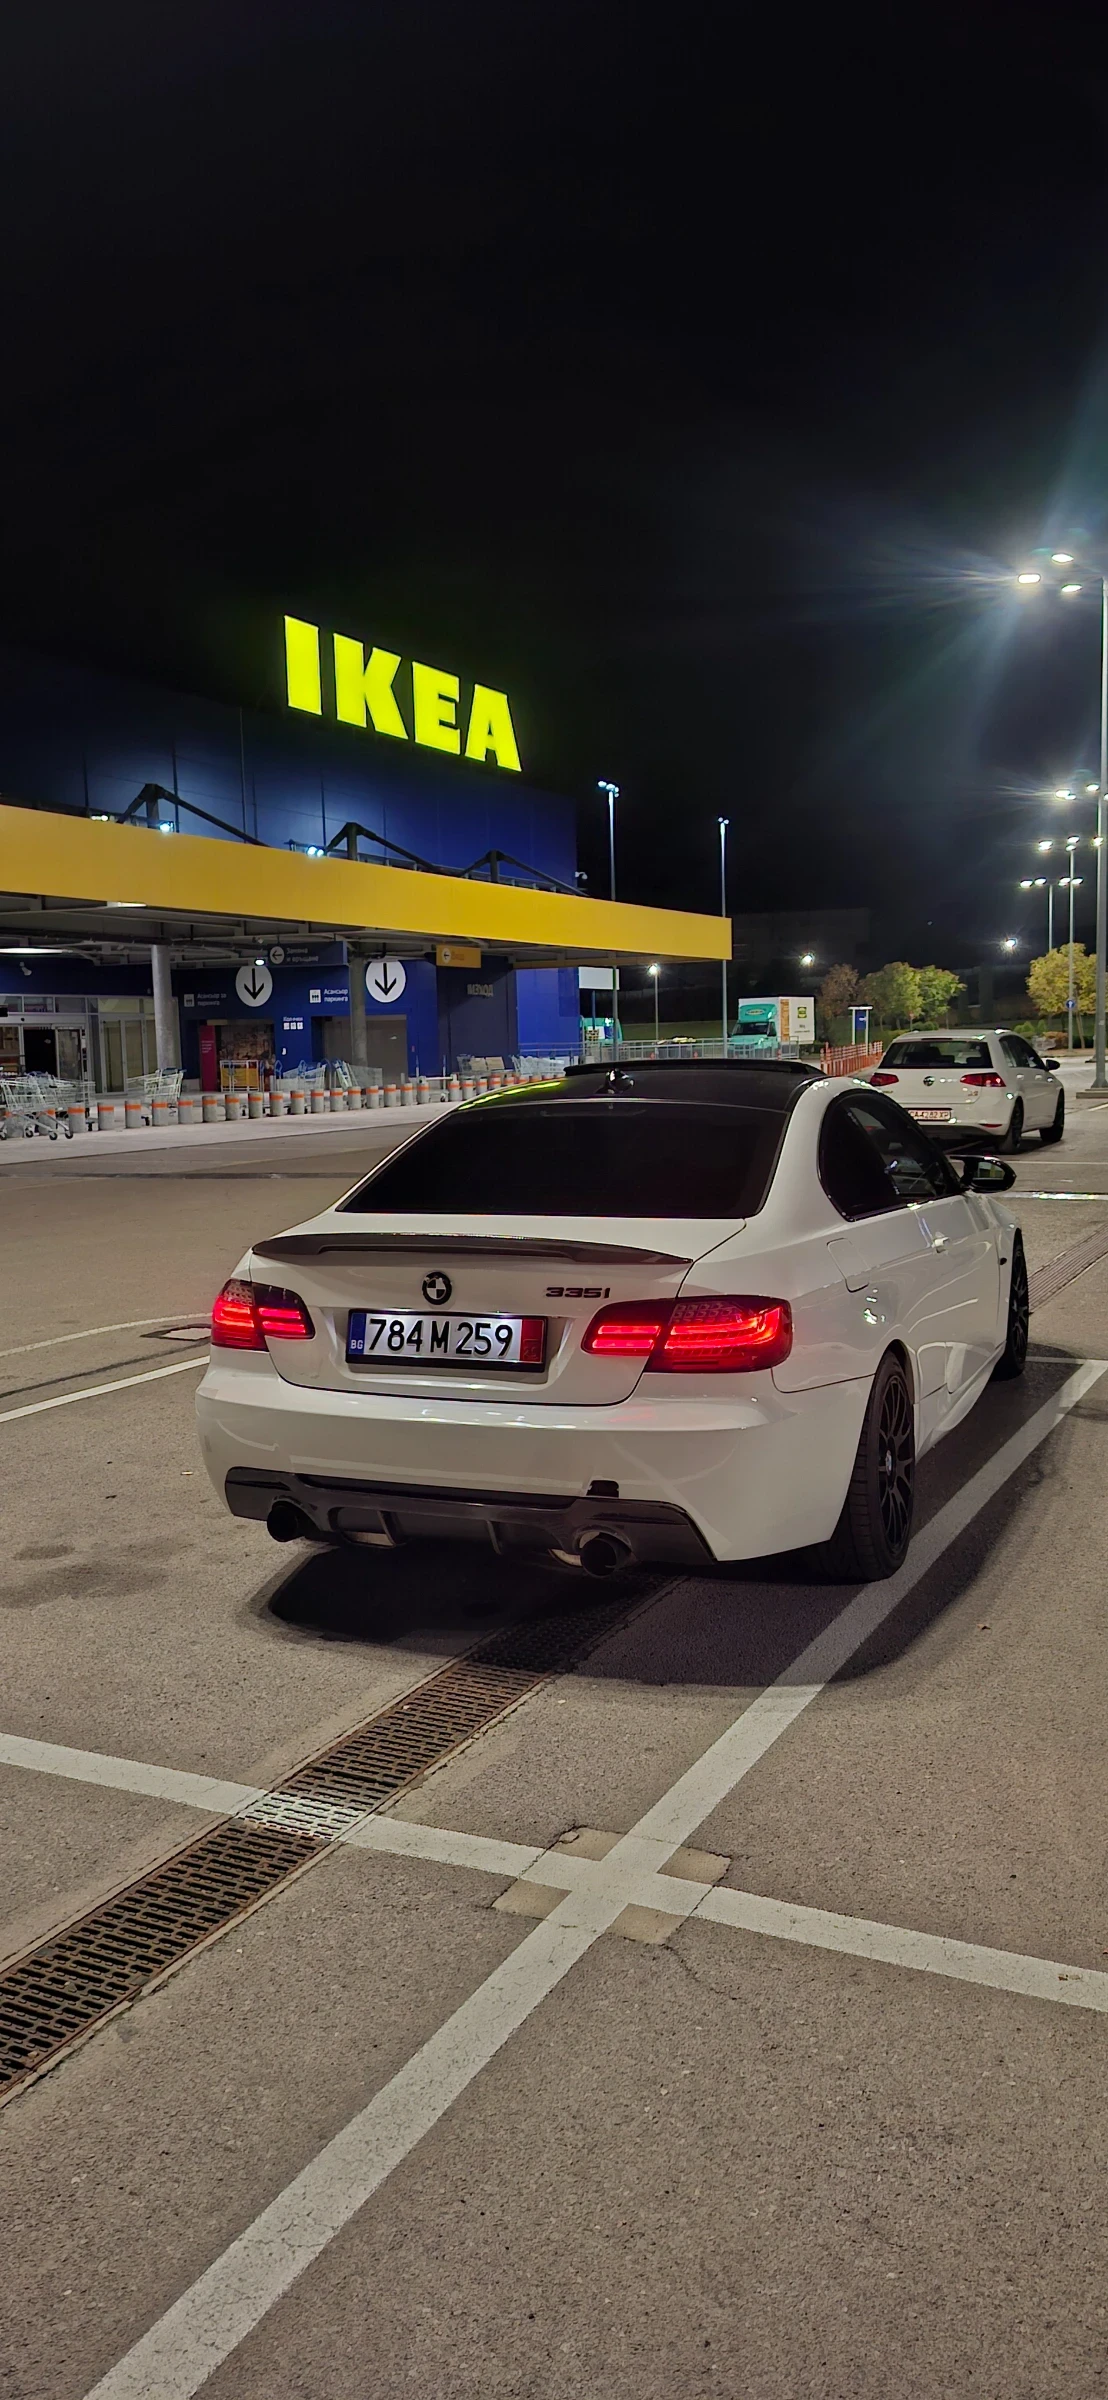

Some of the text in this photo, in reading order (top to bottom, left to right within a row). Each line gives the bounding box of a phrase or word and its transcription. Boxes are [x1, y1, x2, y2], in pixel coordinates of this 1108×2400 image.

[284, 615, 522, 772] IKEA
[350, 1339, 364, 1350] BG
[368, 1318, 514, 1357] 784 M 259
